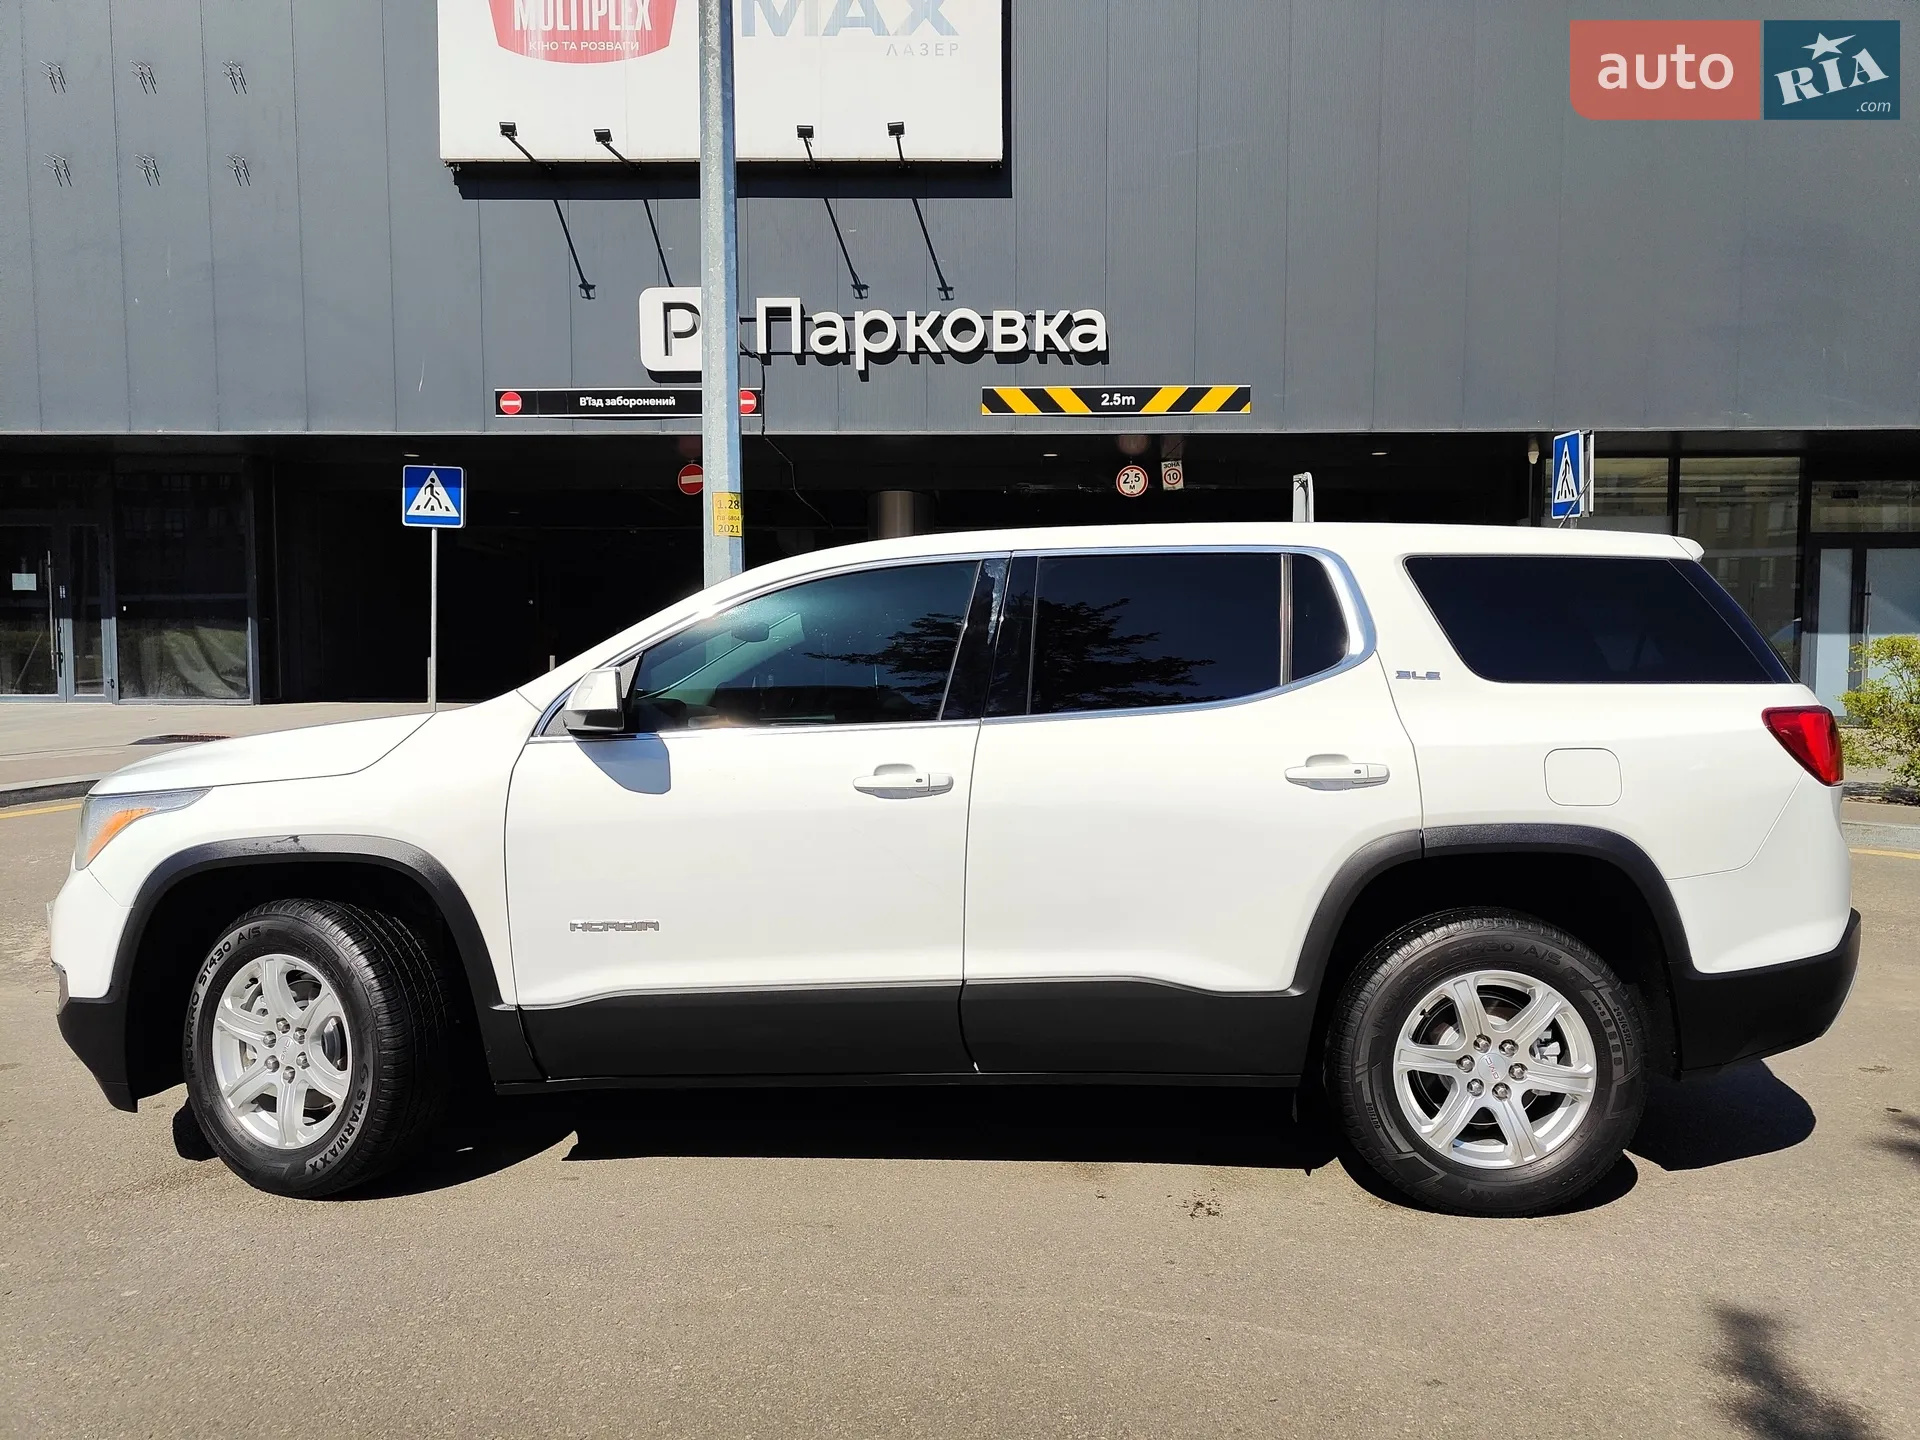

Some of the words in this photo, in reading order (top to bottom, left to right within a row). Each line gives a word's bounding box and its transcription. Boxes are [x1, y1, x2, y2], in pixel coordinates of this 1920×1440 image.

[514, 0, 652, 31] MULTIPLEX
[528, 41, 559, 51] КІНО
[562, 41, 577, 51] ТА
[580, 41, 640, 51] РОЗВАГИ
[886, 43, 959, 57] ЛАЗЕР
[756, 297, 1107, 370] Парковка
[605, 396, 676, 408] заборонений
[1101, 393, 1136, 406] 2.5m
[1122, 473, 1141, 485] 2,5
[1167, 473, 1179, 481] 10
[717, 500, 740, 509] 1.28
[717, 524, 740, 533] 2021
[1395, 671, 1441, 681] SLE
[199, 941, 232, 987] ST430
[237, 926, 261, 945] A/S
[309, 1088, 367, 1173] STARMAXX
